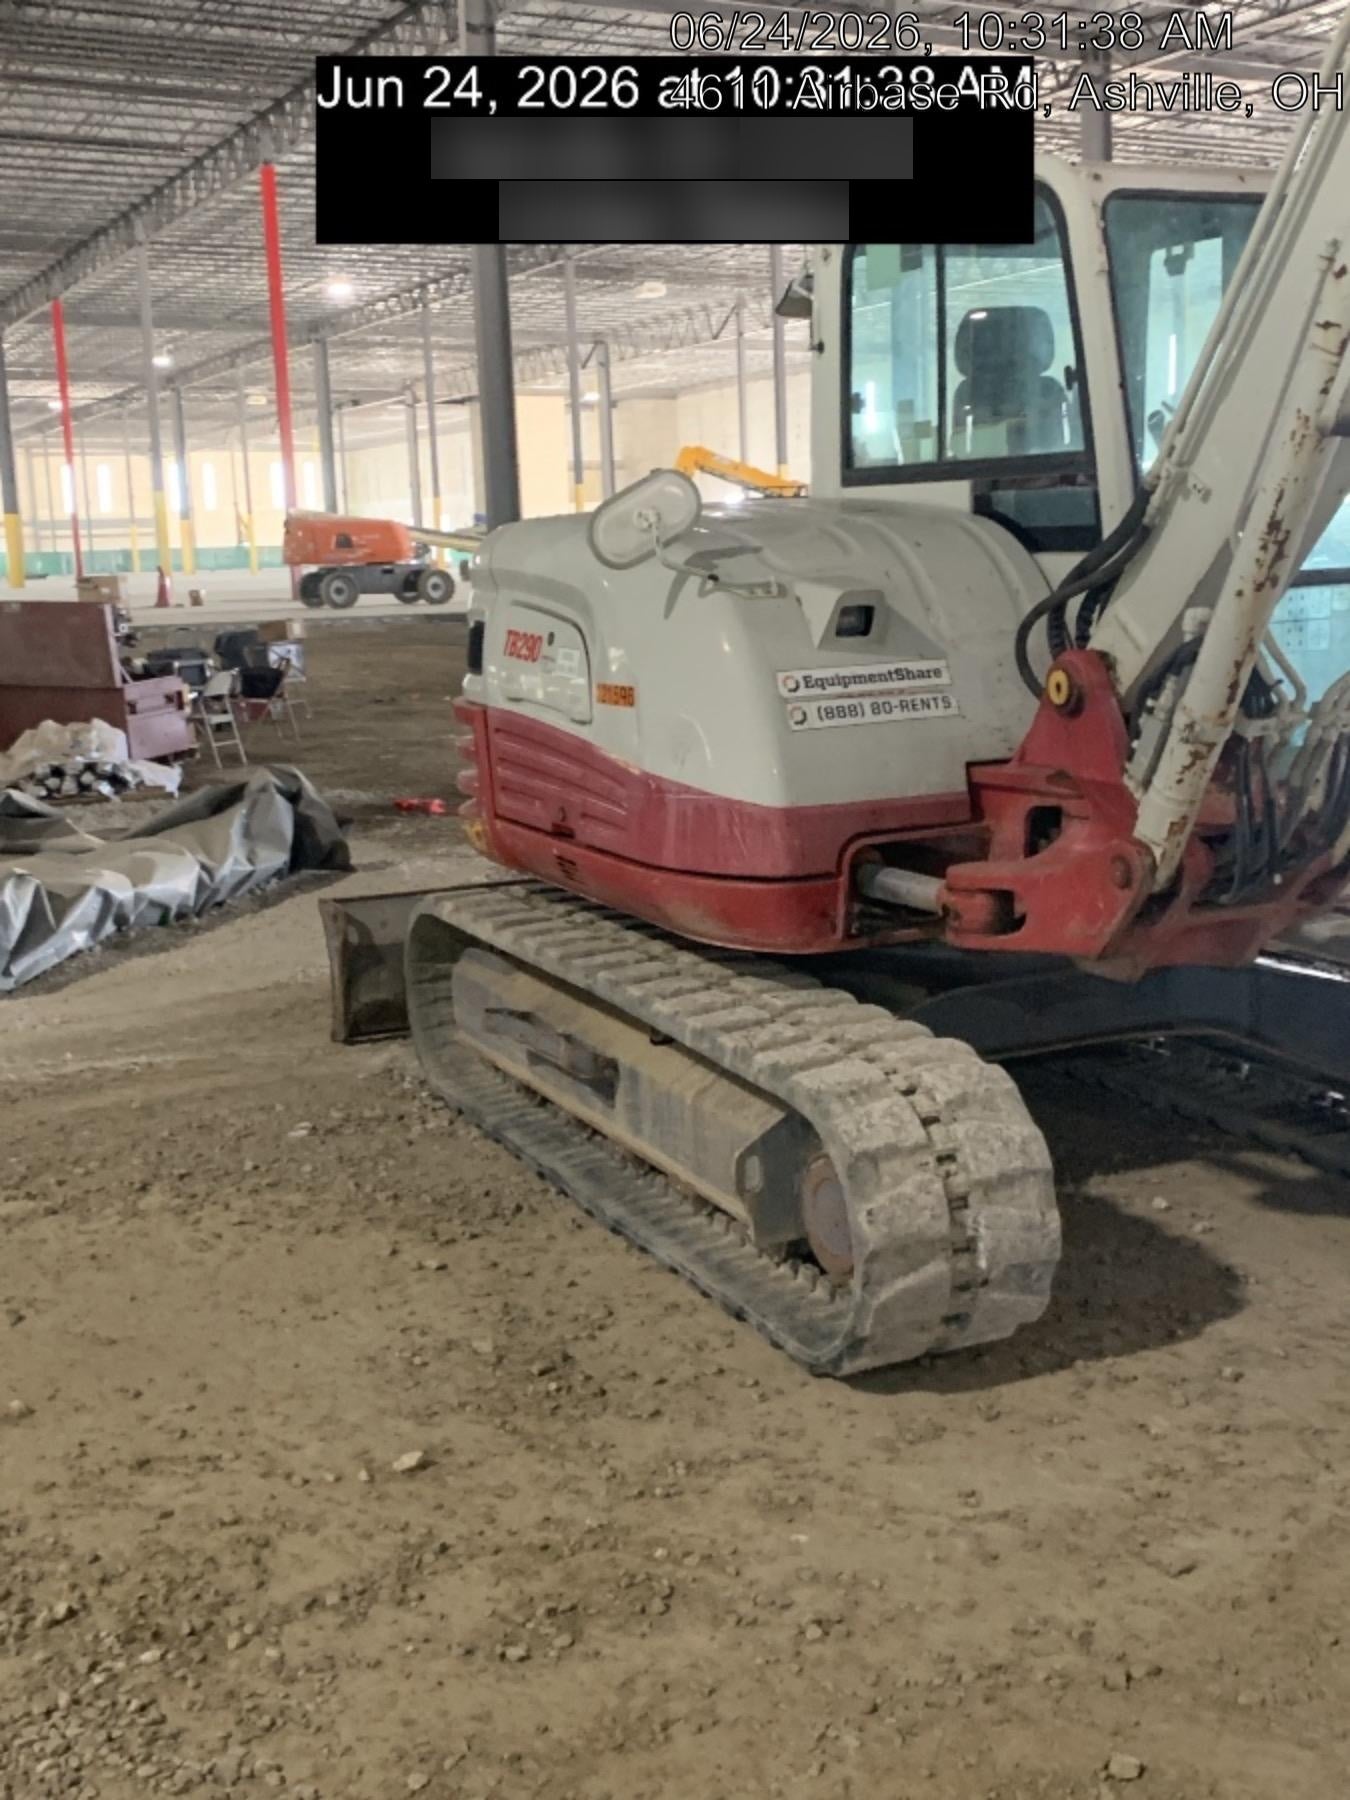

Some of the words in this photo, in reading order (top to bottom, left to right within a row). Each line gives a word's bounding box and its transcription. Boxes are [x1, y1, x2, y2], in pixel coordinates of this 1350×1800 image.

[504, 629, 543, 663] TB290
[802, 667, 943, 690] EquipmentShare
[817, 701, 866, 721] (888)
[870, 696, 952, 716] 80-RENTS
